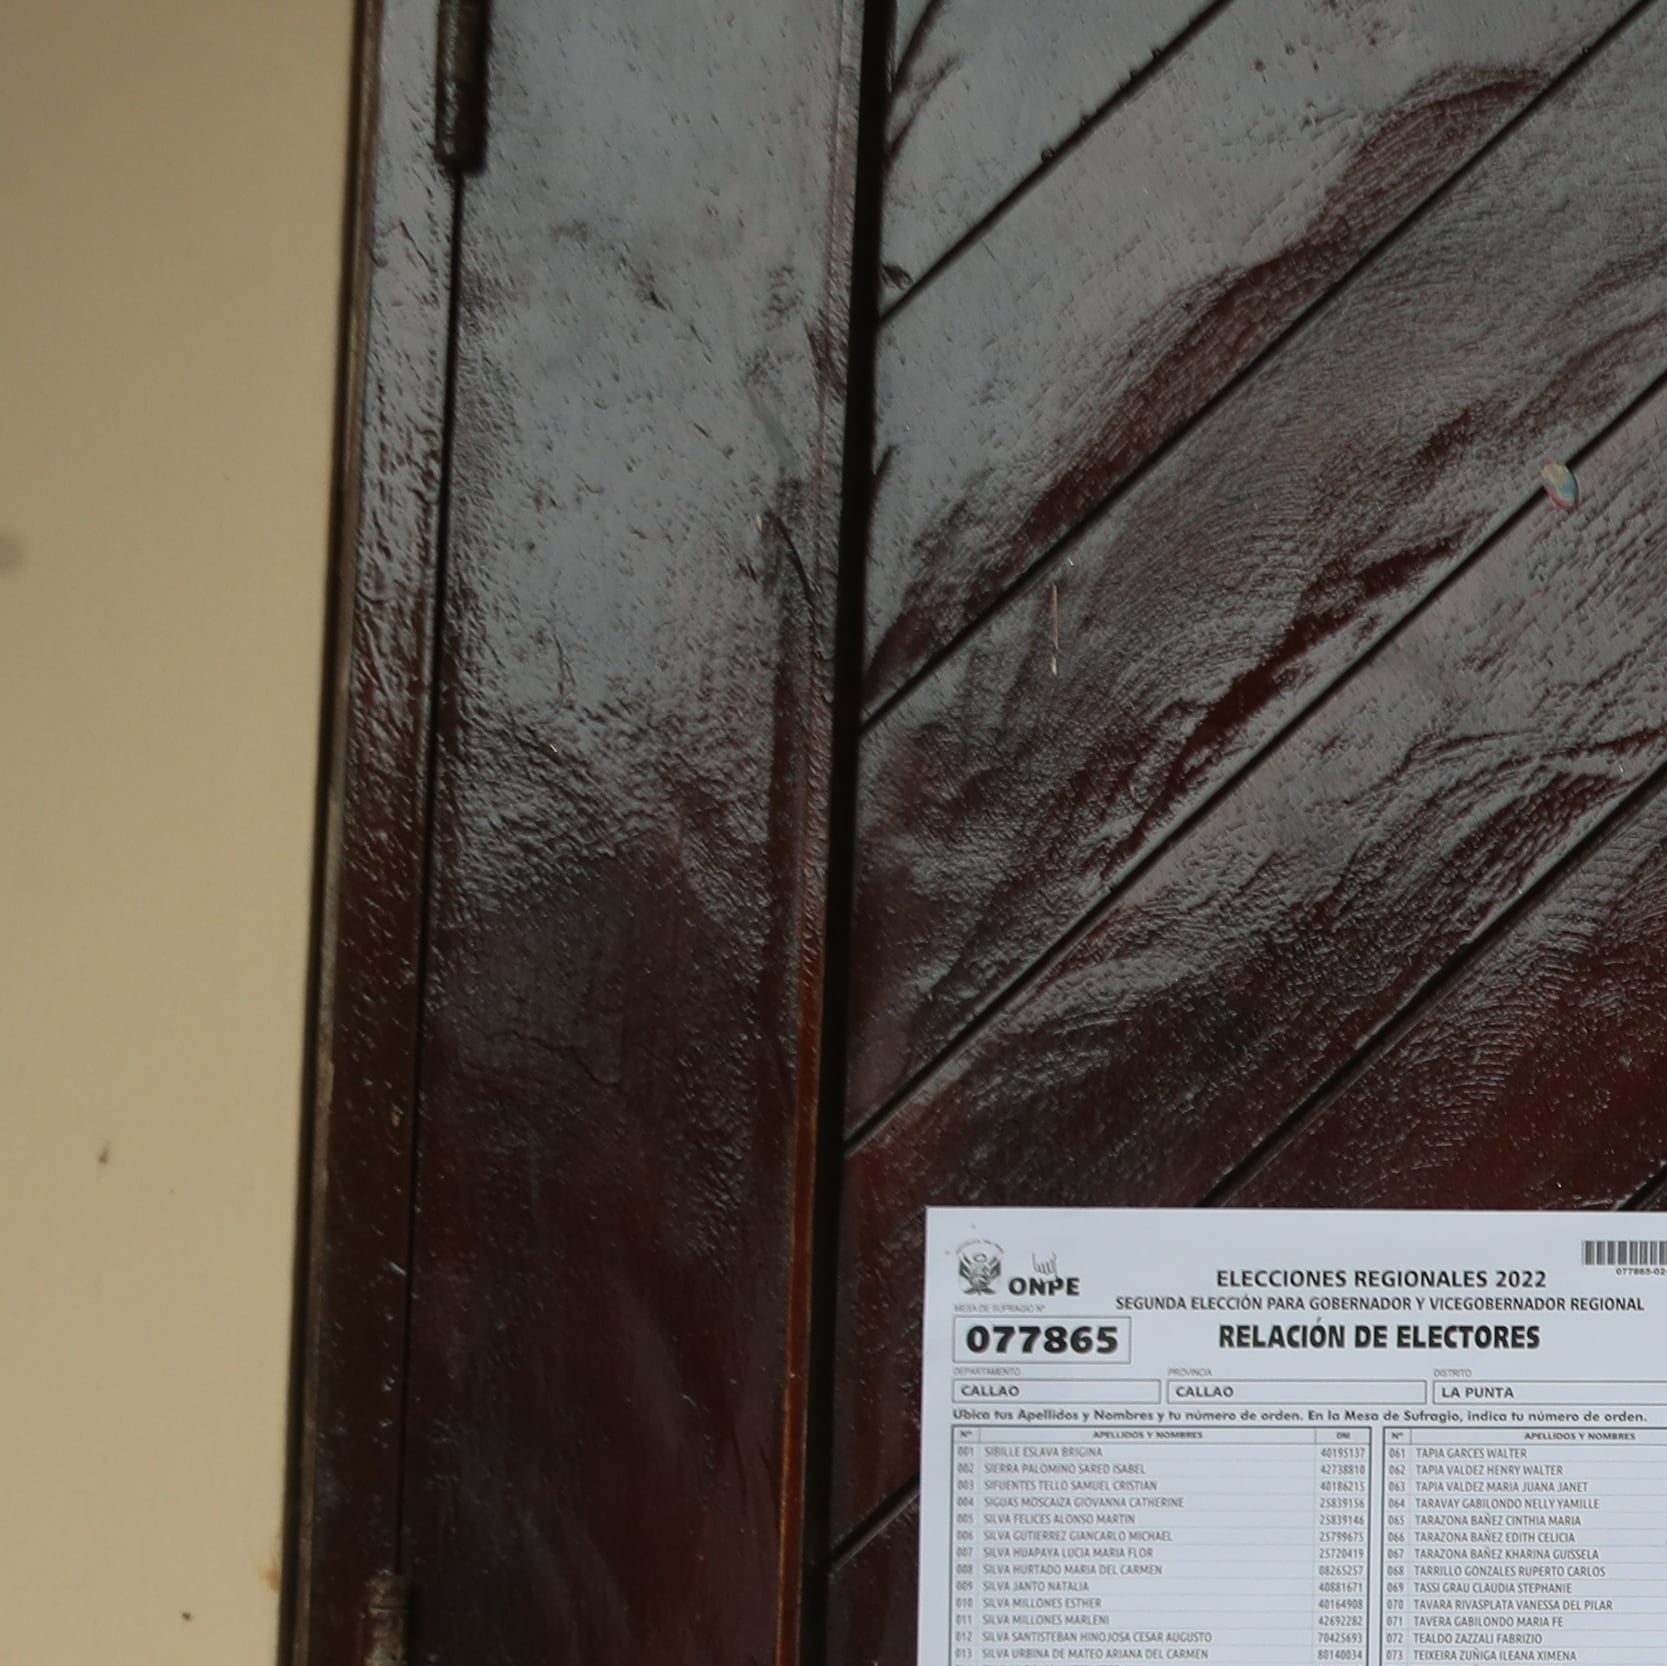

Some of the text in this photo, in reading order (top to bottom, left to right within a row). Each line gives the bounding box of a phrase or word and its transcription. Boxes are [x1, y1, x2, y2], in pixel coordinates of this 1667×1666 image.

[1008, 1275, 1079, 1296] ONPE
[1217, 1270, 1545, 1287] ELECCIONES REGIONALES 2022
[1116, 1294, 1644, 1310] SEGUNDA ELECCIÓN PARA GOBERNADOR Y VICEGOBERNADOR REGIONAL
[966, 1325, 1117, 1354] 077865
[1219, 1317, 1539, 1349] RELACIÓN DE ELECTORES
[960, 1385, 1019, 1396] CALLAO
[1175, 1385, 1233, 1397] CALLAO
[1441, 1386, 1514, 1398] LA PUNTA
[1416, 1447, 1527, 1459] TAPIA GARCES WALTER
